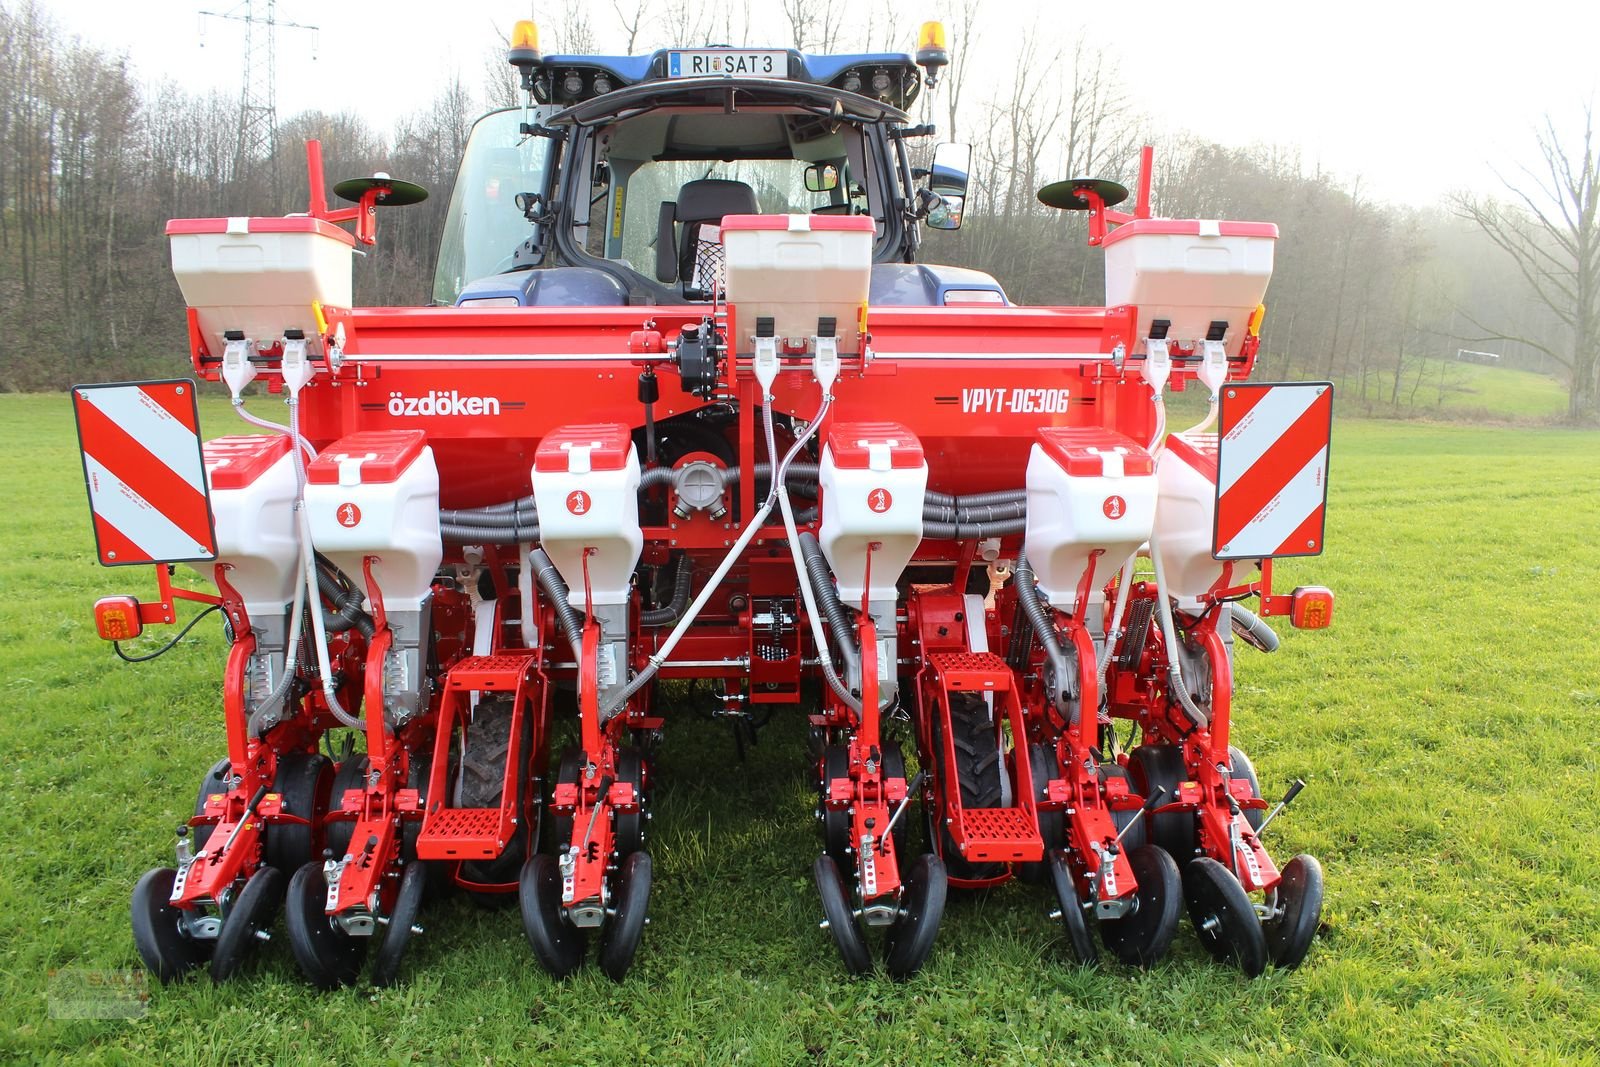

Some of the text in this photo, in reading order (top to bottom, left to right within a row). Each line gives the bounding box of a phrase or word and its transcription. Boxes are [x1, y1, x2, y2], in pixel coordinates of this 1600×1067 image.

[693, 55, 773, 73] RI SAT 3
[388, 390, 500, 416] özdöken
[962, 388, 1070, 413] VPYT-DG306
